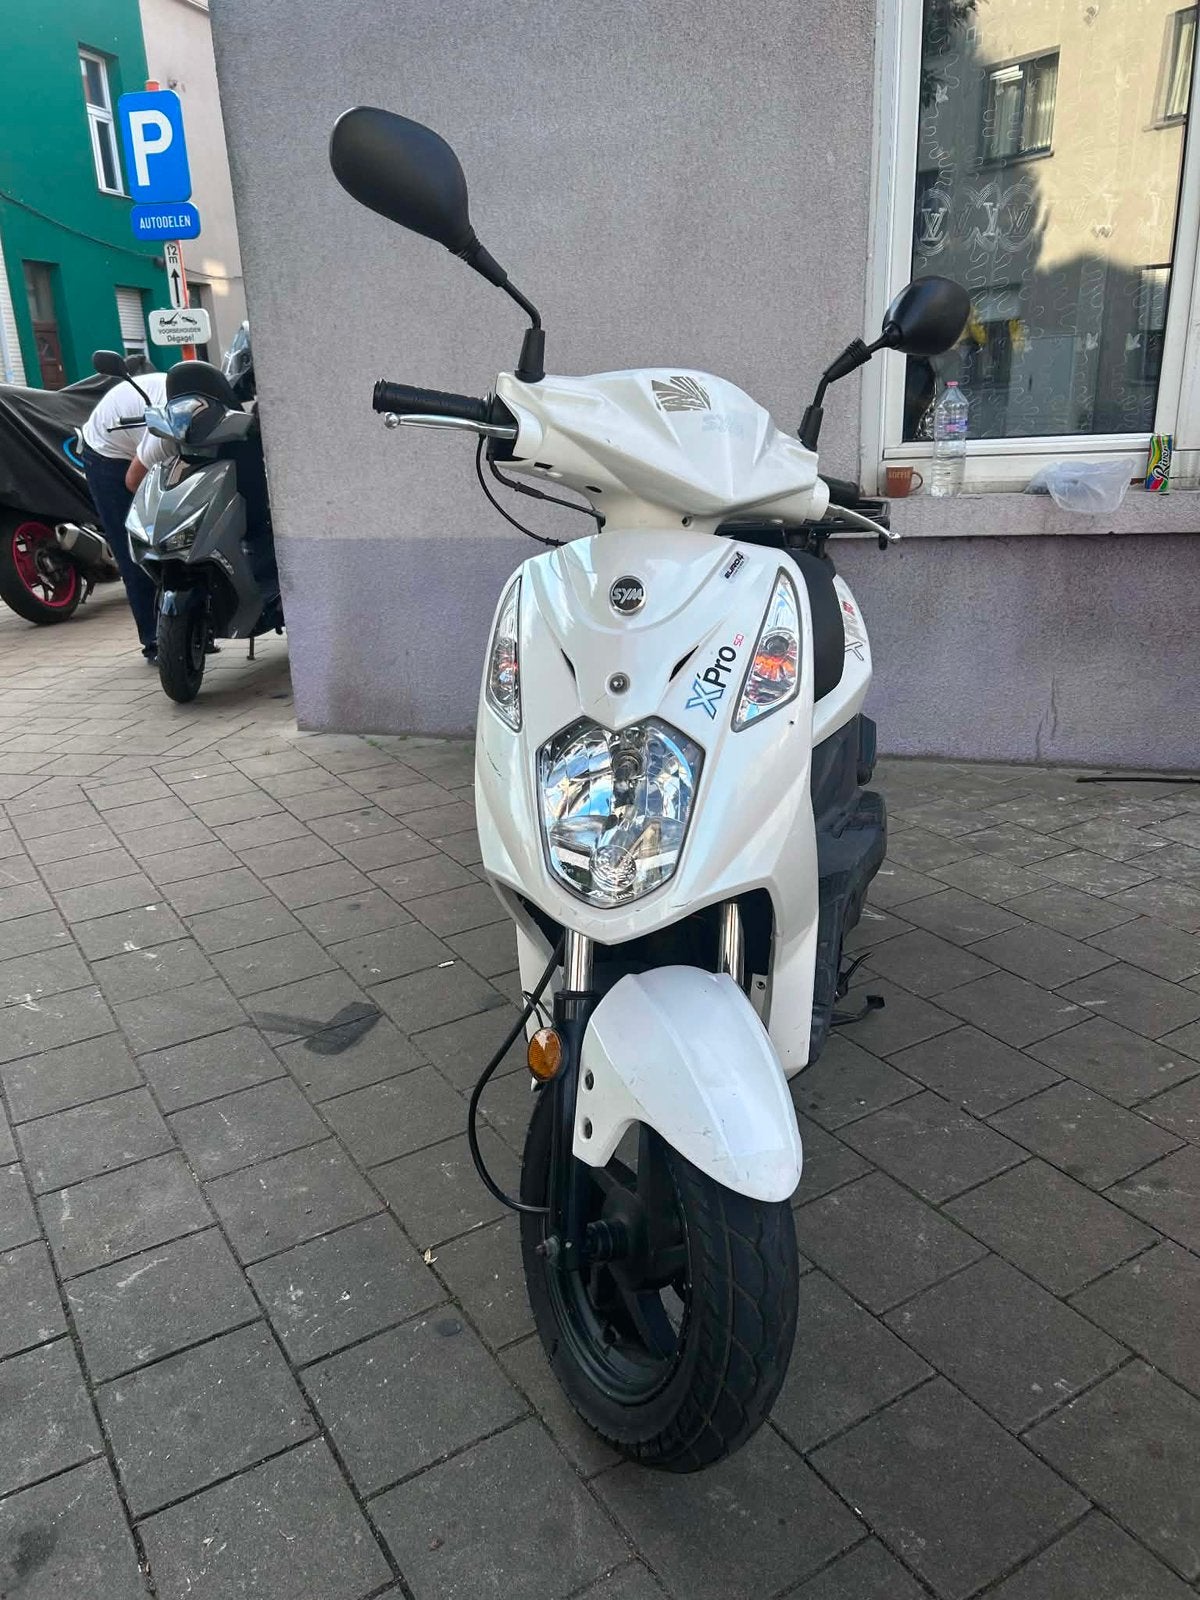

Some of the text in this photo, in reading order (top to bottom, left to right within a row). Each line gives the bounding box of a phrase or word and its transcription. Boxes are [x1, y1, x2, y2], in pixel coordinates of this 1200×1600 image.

[128, 109, 173, 187] P
[139, 215, 191, 229] AUTODELEN
[612, 587, 643, 604] SYM
